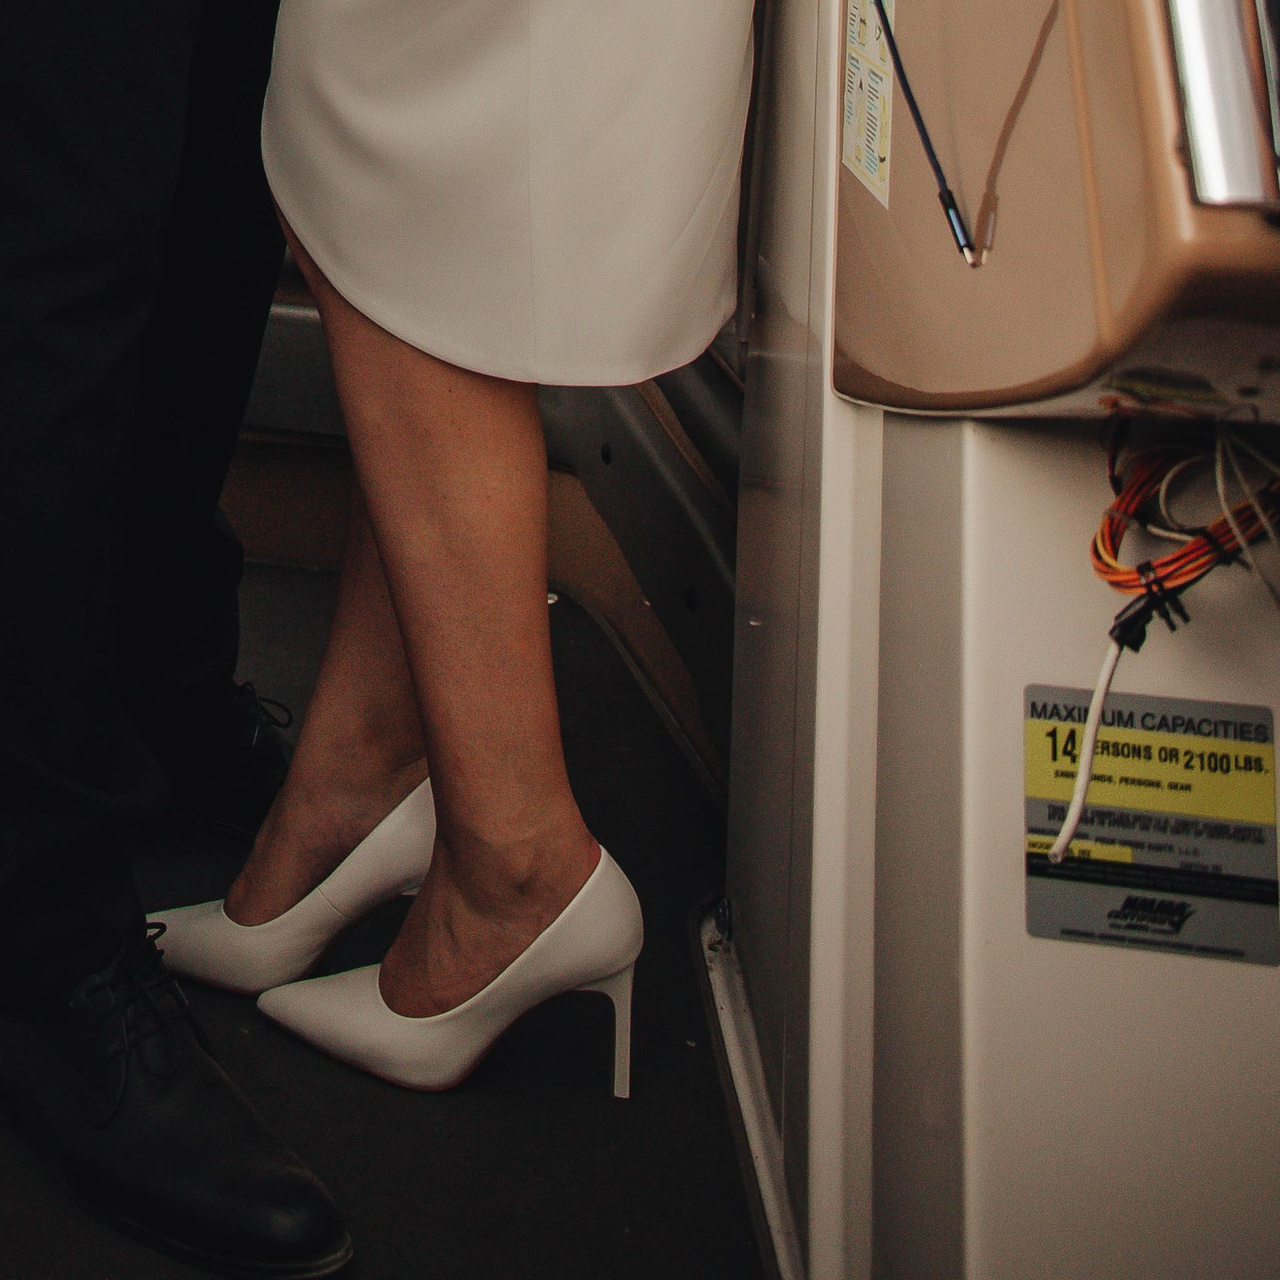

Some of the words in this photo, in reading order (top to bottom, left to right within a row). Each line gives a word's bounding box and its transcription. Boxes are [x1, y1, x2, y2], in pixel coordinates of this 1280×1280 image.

[1030, 702, 1134, 728] MAXIUM
[1140, 712, 1269, 743] CAPACITIES
[1046, 727, 1077, 764] 14
[1091, 739, 1153, 761] ERSONS
[1158, 746, 1179, 764] OR
[1183, 751, 1231, 774] 2100
